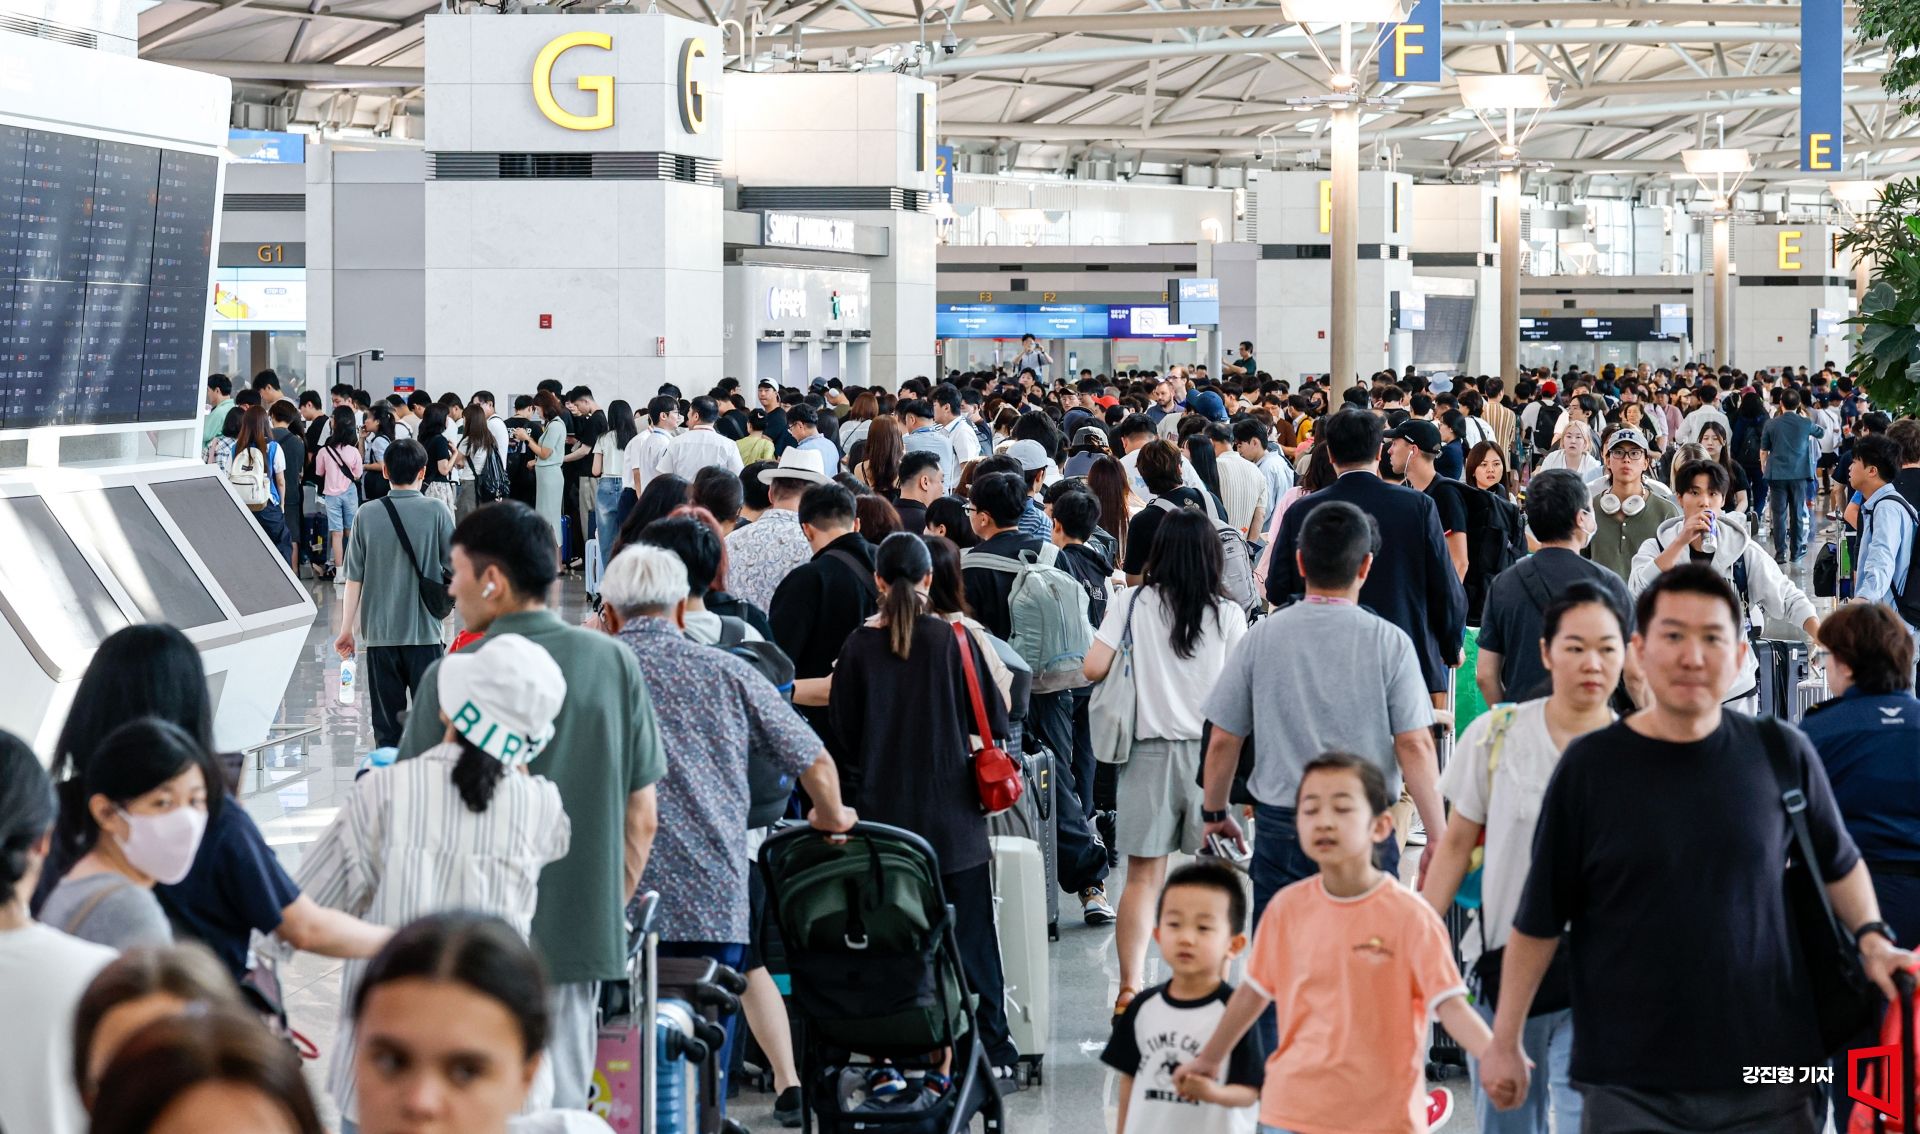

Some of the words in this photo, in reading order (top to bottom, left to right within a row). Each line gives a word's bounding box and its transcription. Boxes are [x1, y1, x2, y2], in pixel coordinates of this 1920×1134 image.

[1394, 24, 1425, 77] F
[532, 31, 615, 132] G
[677, 37, 706, 134] G
[1809, 133, 1832, 170] E
[257, 244, 283, 263] G1
[1778, 231, 1802, 270] E
[979, 291, 993, 303] F3
[1043, 292, 1057, 303] F2
[1618, 431, 1635, 439] NY
[1147, 1031, 1177, 1052] TIME
